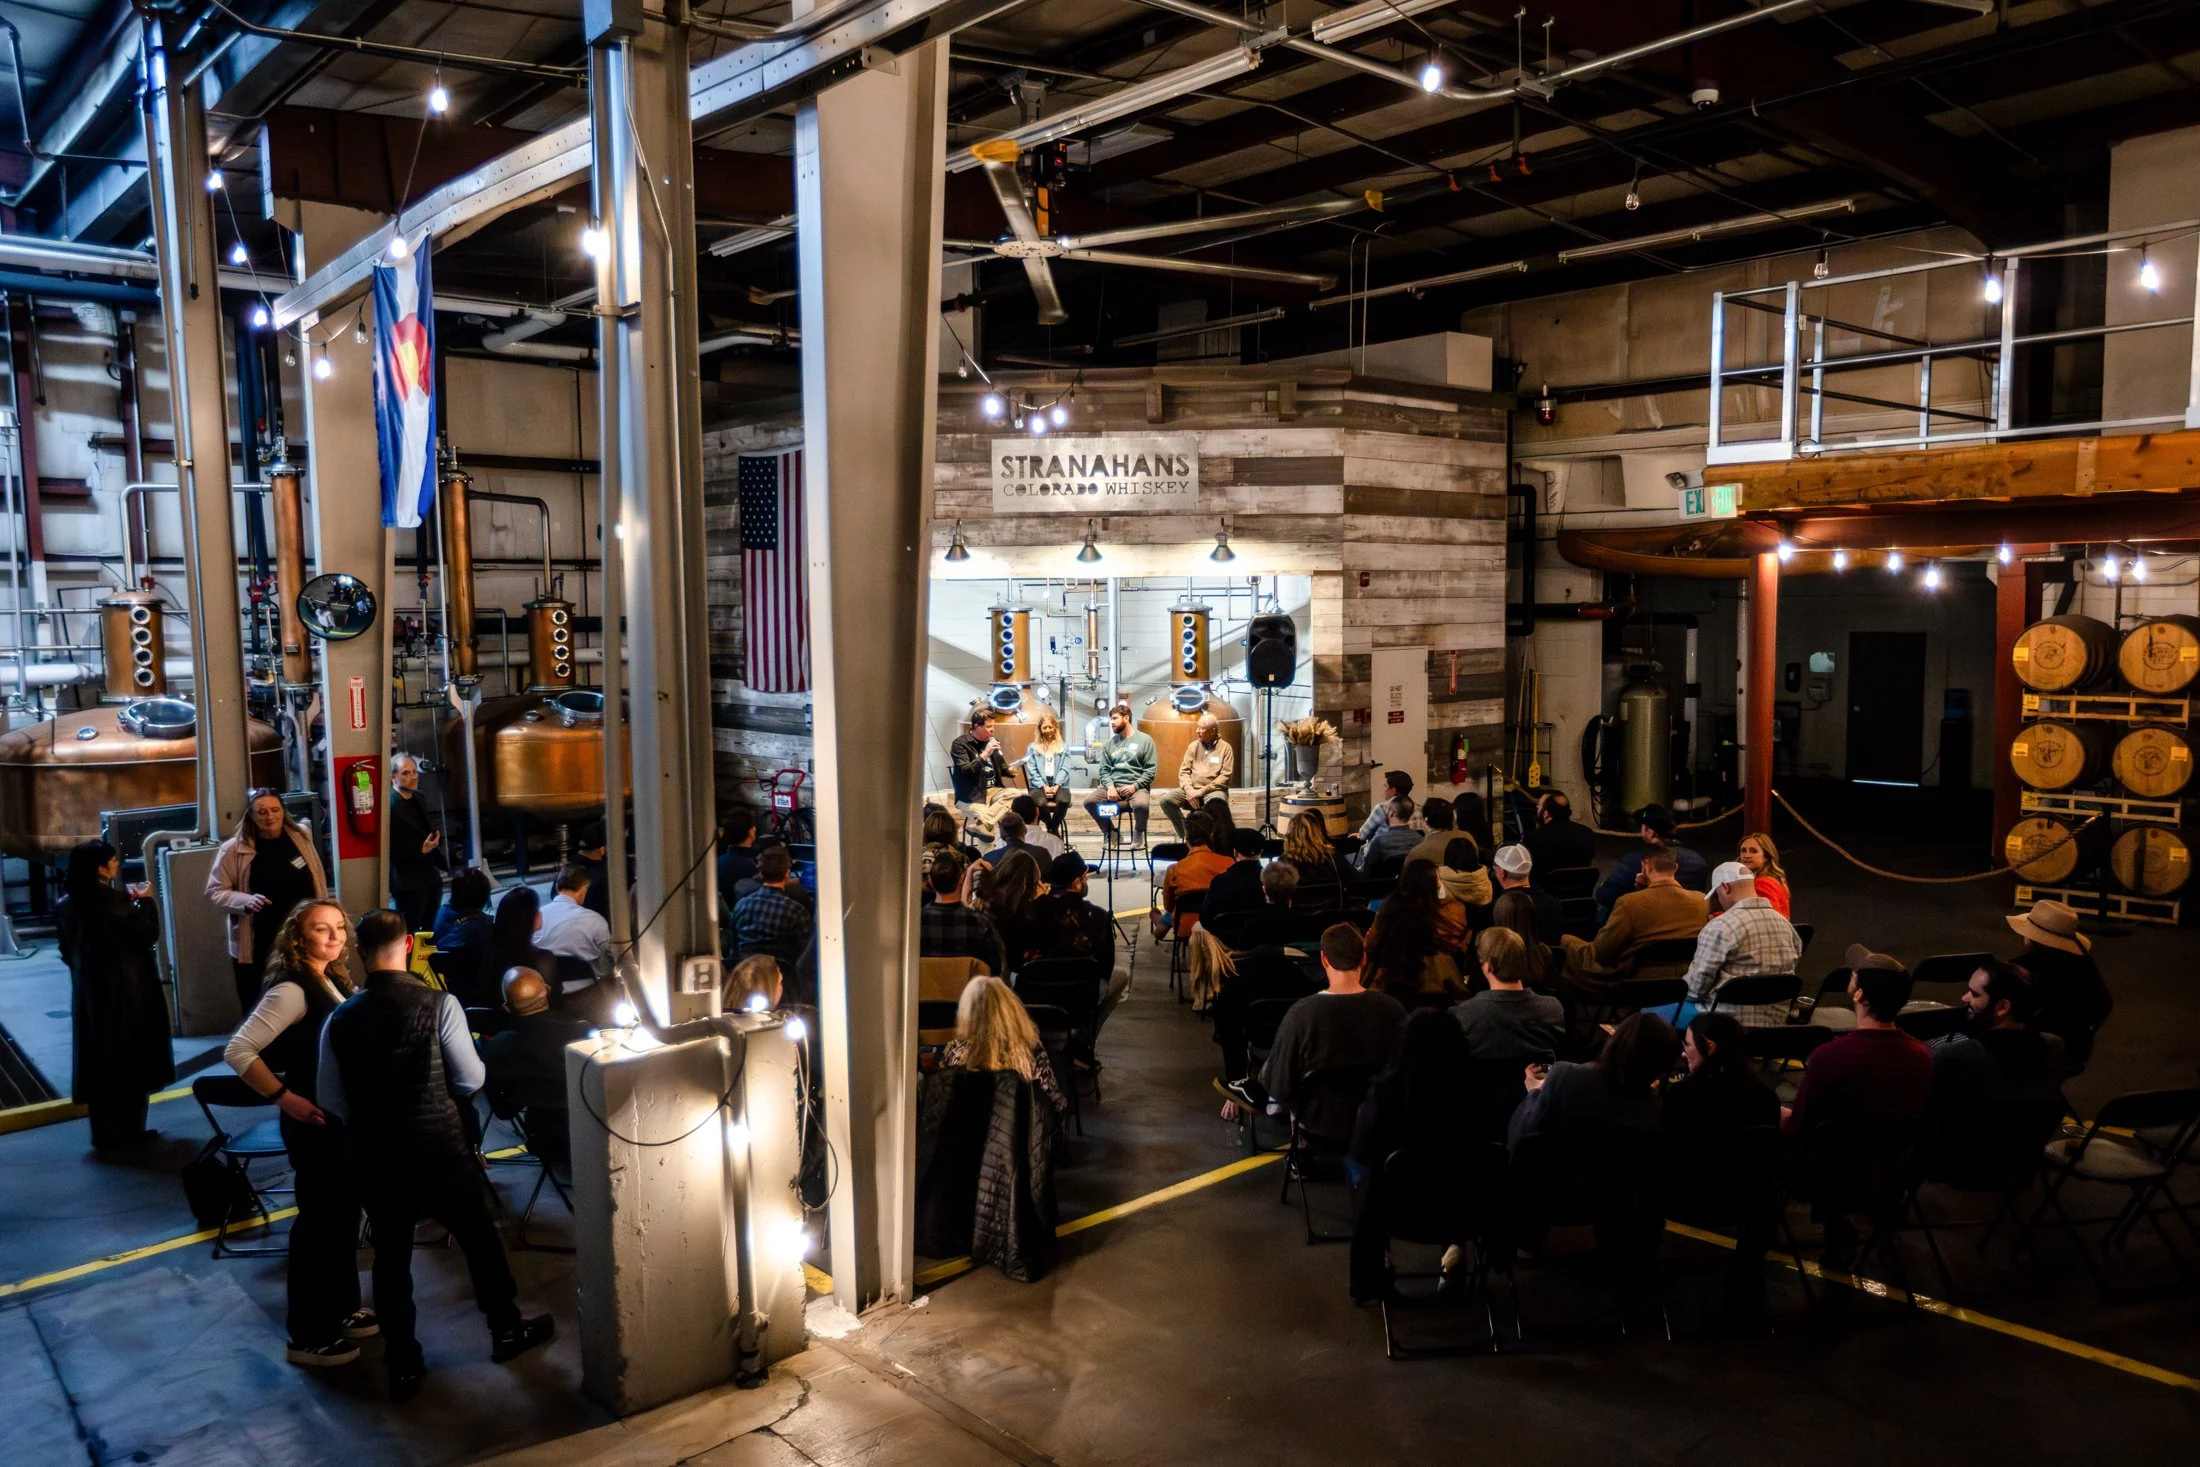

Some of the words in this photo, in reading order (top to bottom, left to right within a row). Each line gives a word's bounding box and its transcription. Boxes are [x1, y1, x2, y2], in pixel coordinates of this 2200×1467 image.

[1001, 453, 1190, 478] STRANAHANS
[1003, 482, 1098, 496] COLORADO
[1105, 481, 1189, 495] WHISKEY
[1715, 486, 1734, 515] EXIT
[1685, 489, 1704, 515] EX
